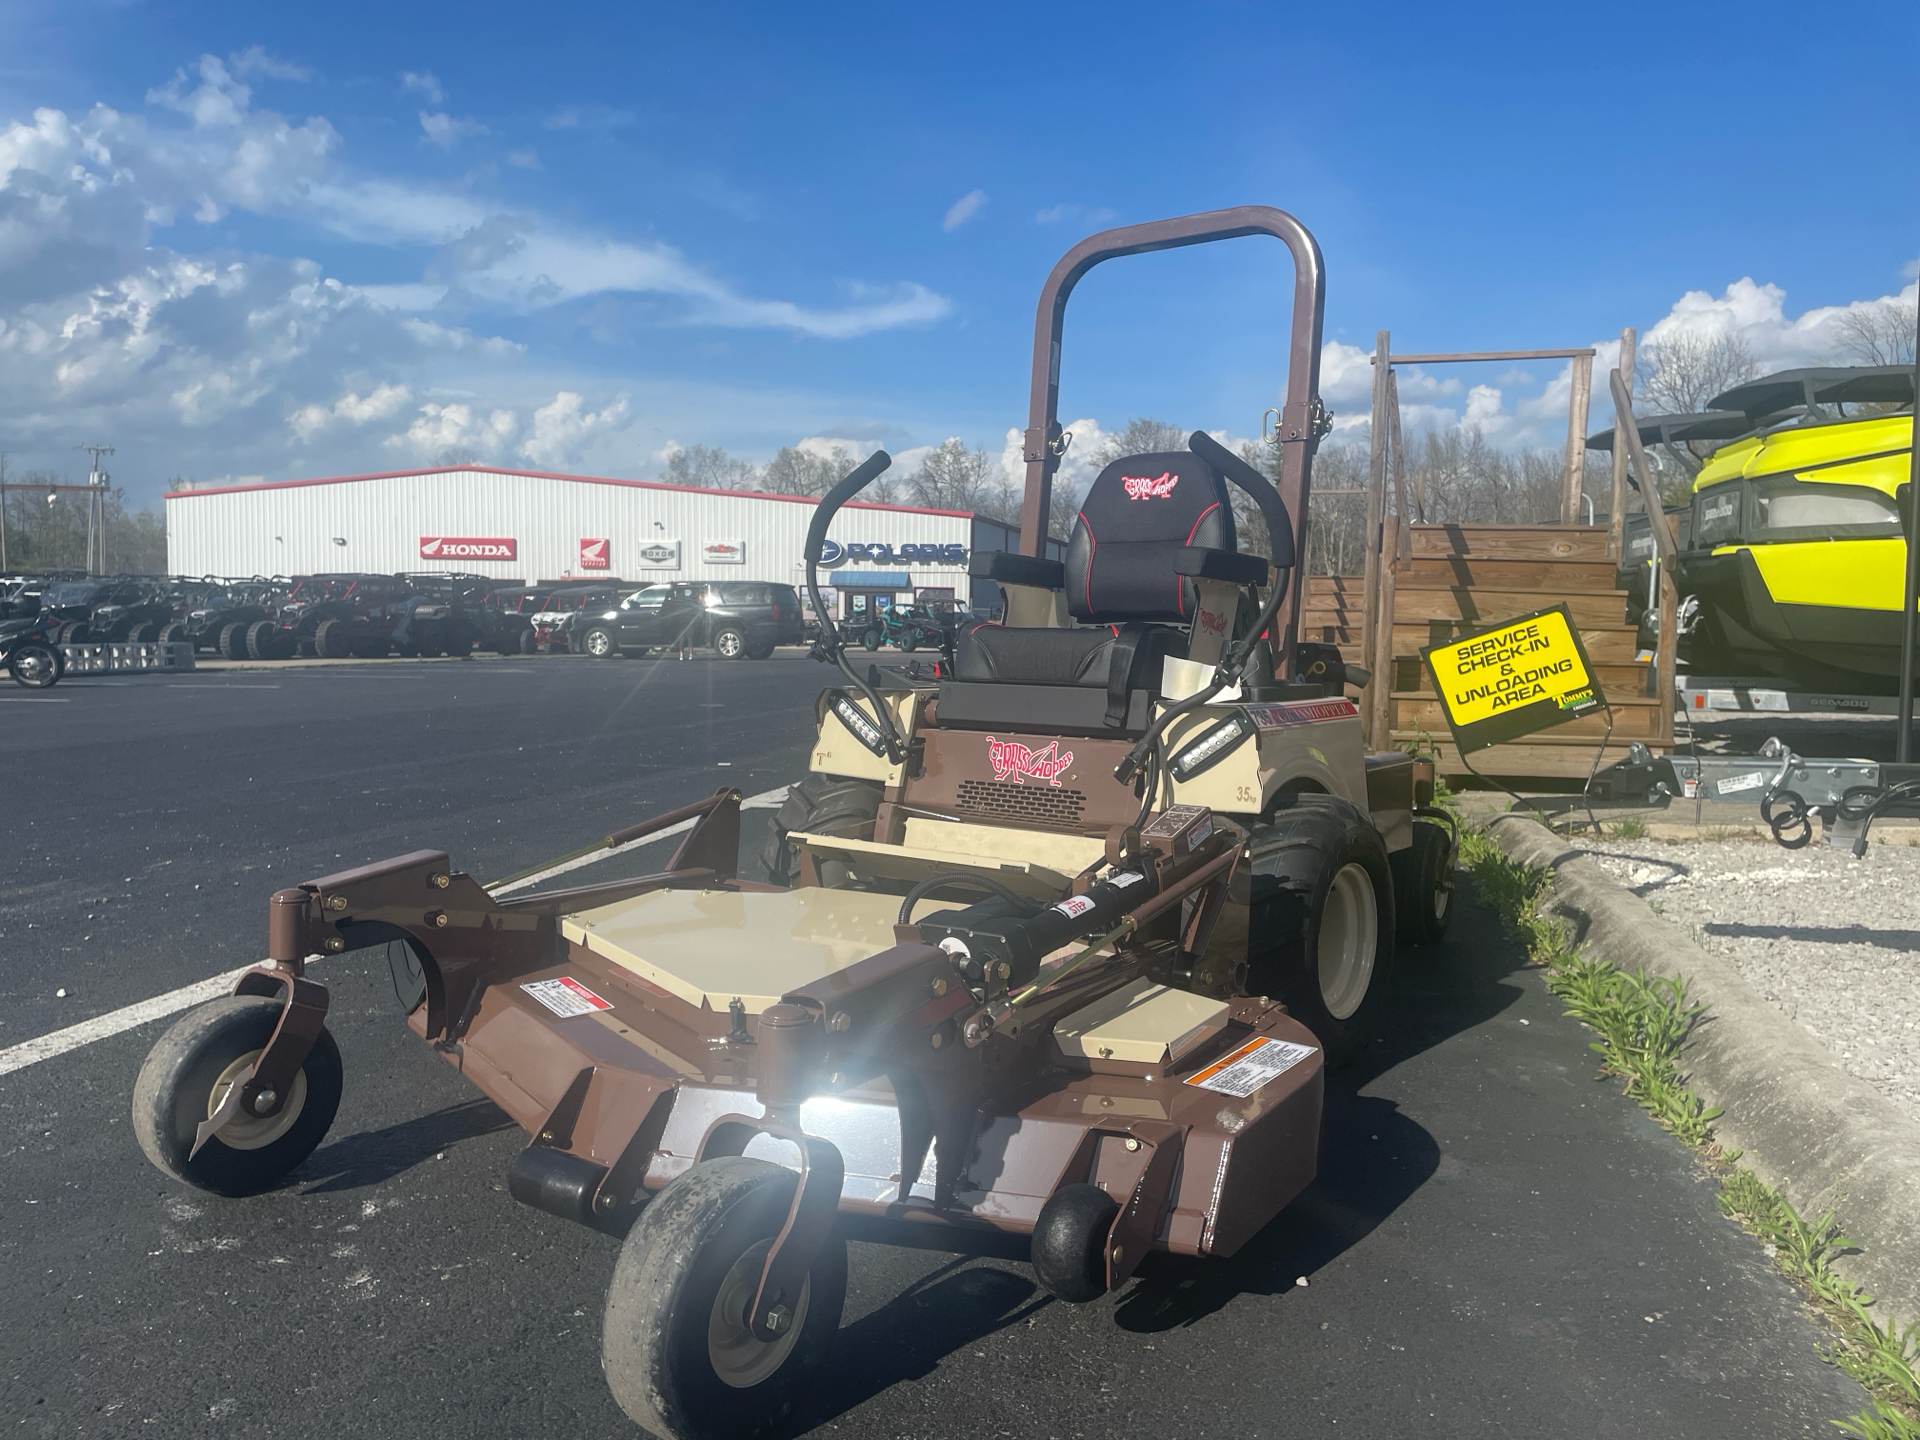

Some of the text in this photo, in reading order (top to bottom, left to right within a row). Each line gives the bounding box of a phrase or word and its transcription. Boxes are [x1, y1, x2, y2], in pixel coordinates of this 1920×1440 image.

[441, 544, 511, 556] HONDA
[847, 543, 964, 560] POLARIS
[1457, 625, 1539, 661] SERVICE
[1457, 636, 1550, 675] CHECK-IN
[1500, 663, 1515, 676] &
[1456, 659, 1573, 705] UNLOADING
[1492, 683, 1546, 710] AREA
[1250, 703, 1350, 727] 735 GRASSHOPPER
[1068, 901, 1087, 915] STEP
